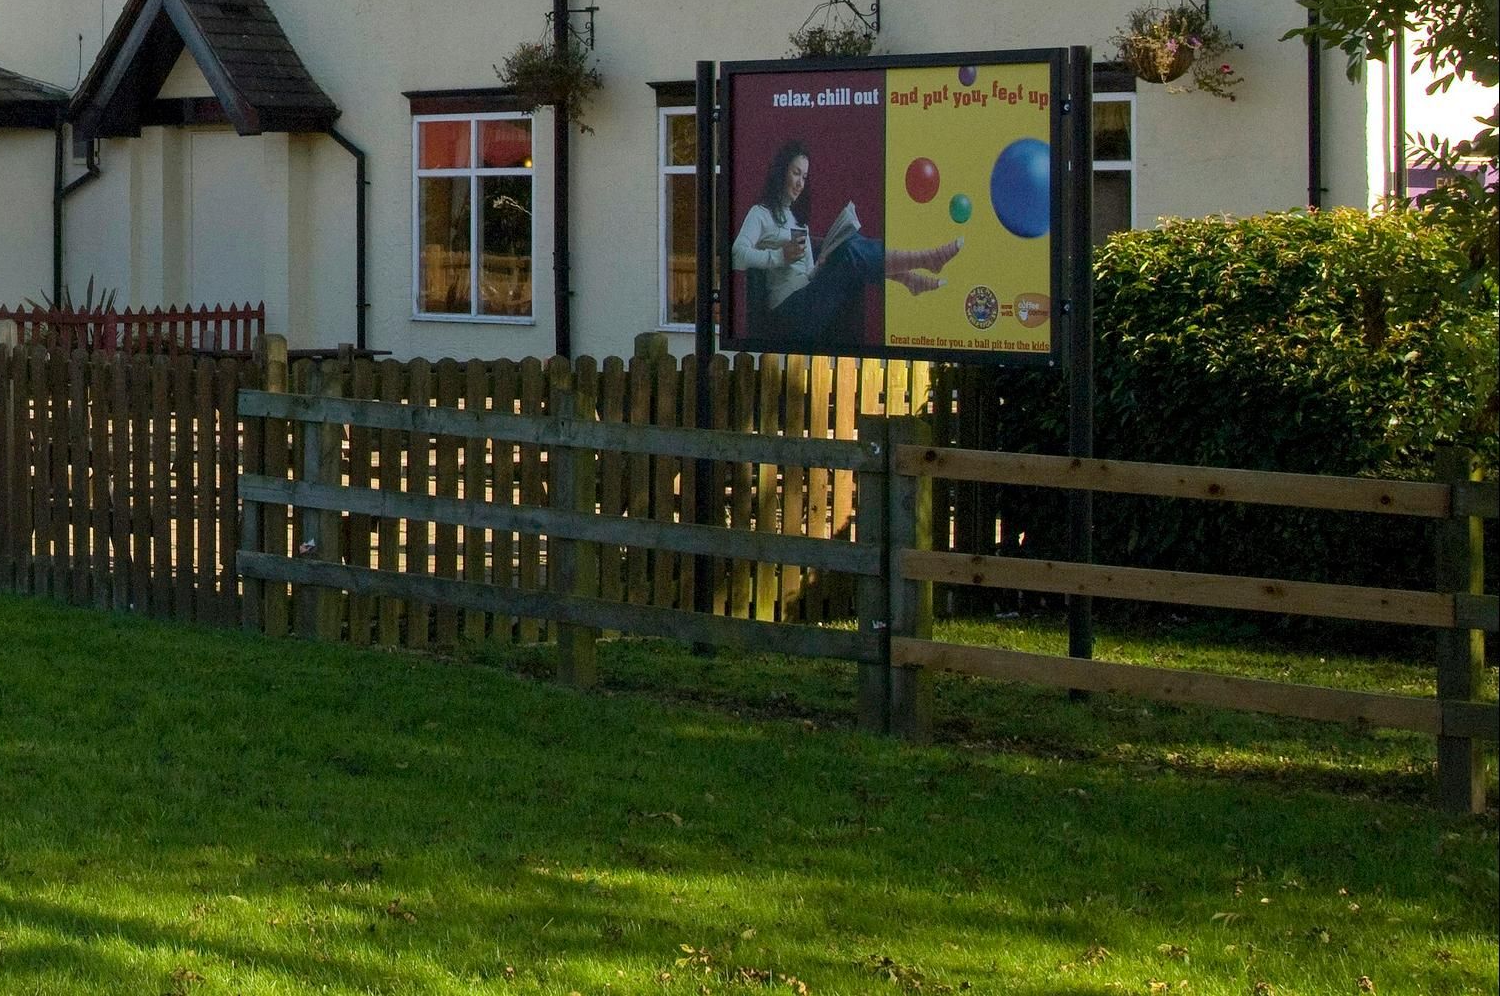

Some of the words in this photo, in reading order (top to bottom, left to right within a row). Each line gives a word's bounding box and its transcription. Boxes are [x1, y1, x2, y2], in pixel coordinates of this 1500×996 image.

[773, 89, 814, 108] relax,
[817, 88, 850, 105] chill
[854, 88, 879, 105] out
[891, 86, 918, 105] and
[923, 84, 948, 110] put
[953, 89, 988, 108] your
[992, 80, 1023, 105] feet
[1028, 90, 1049, 110] up
[891, 335, 909, 344] Great
[911, 336, 934, 345] coffee
[937, 337, 947, 346] for
[967, 339, 972, 347] a
[974, 339, 989, 348] ball
[1004, 340, 1015, 349] for
[1017, 340, 1030, 349] the
[1032, 341, 1050, 351] kids
